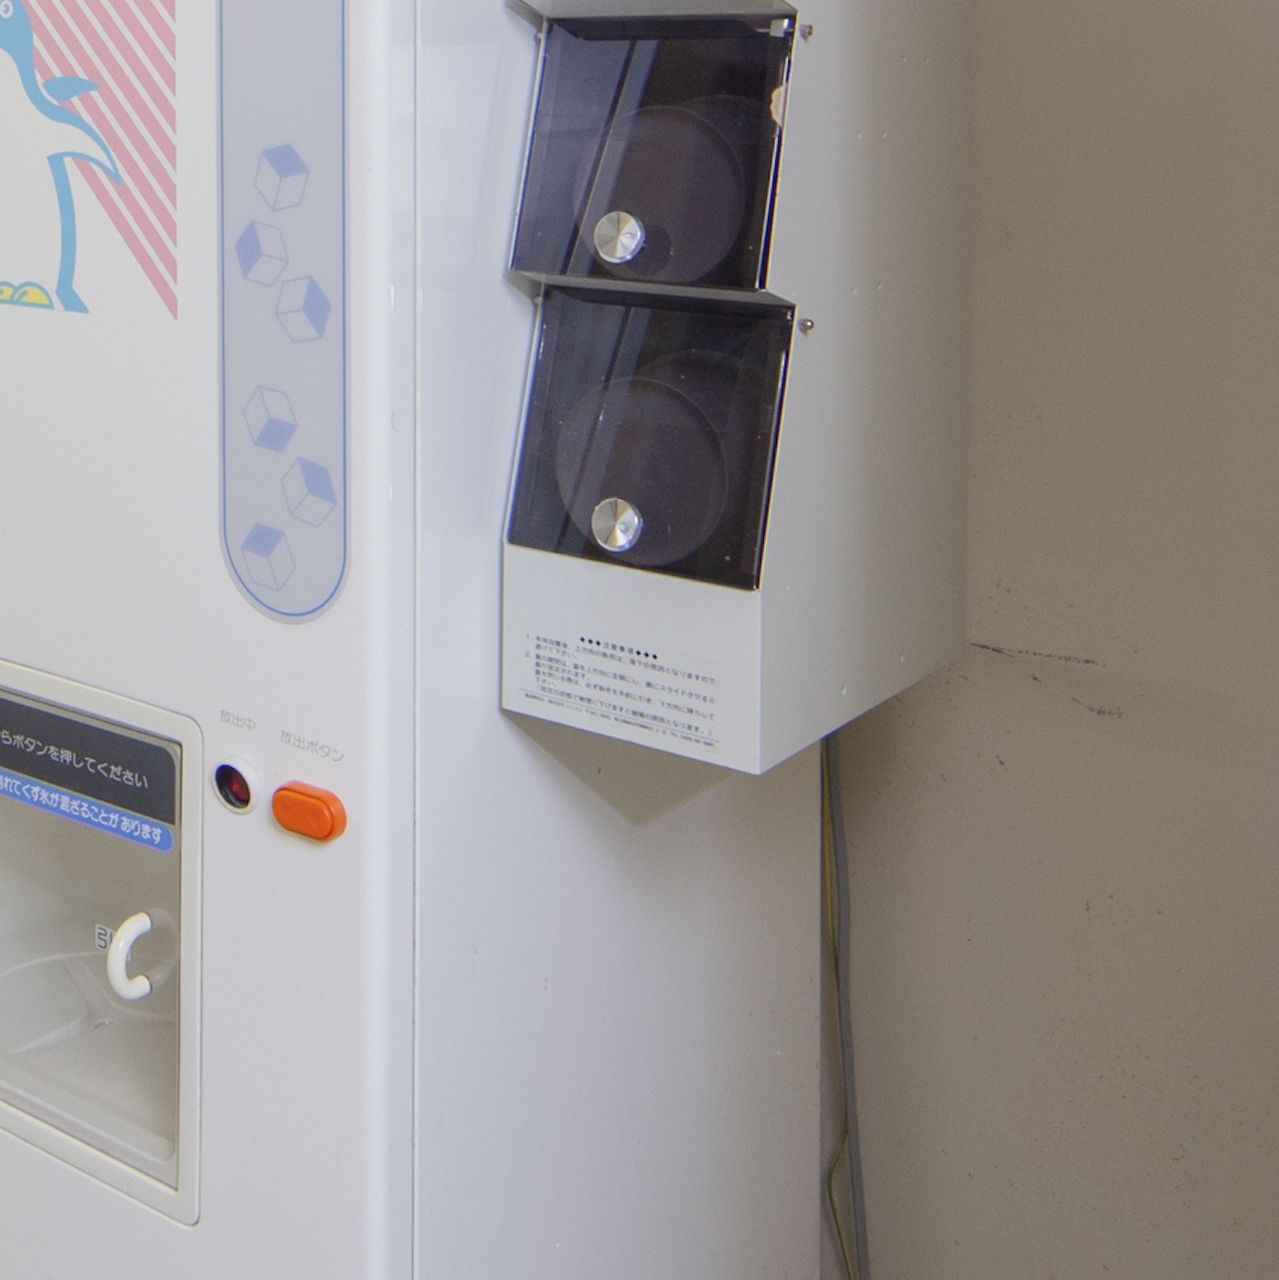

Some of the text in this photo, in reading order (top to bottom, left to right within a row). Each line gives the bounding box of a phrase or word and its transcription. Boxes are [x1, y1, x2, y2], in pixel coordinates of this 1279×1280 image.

[280, 728, 345, 762] 放出ボタン
